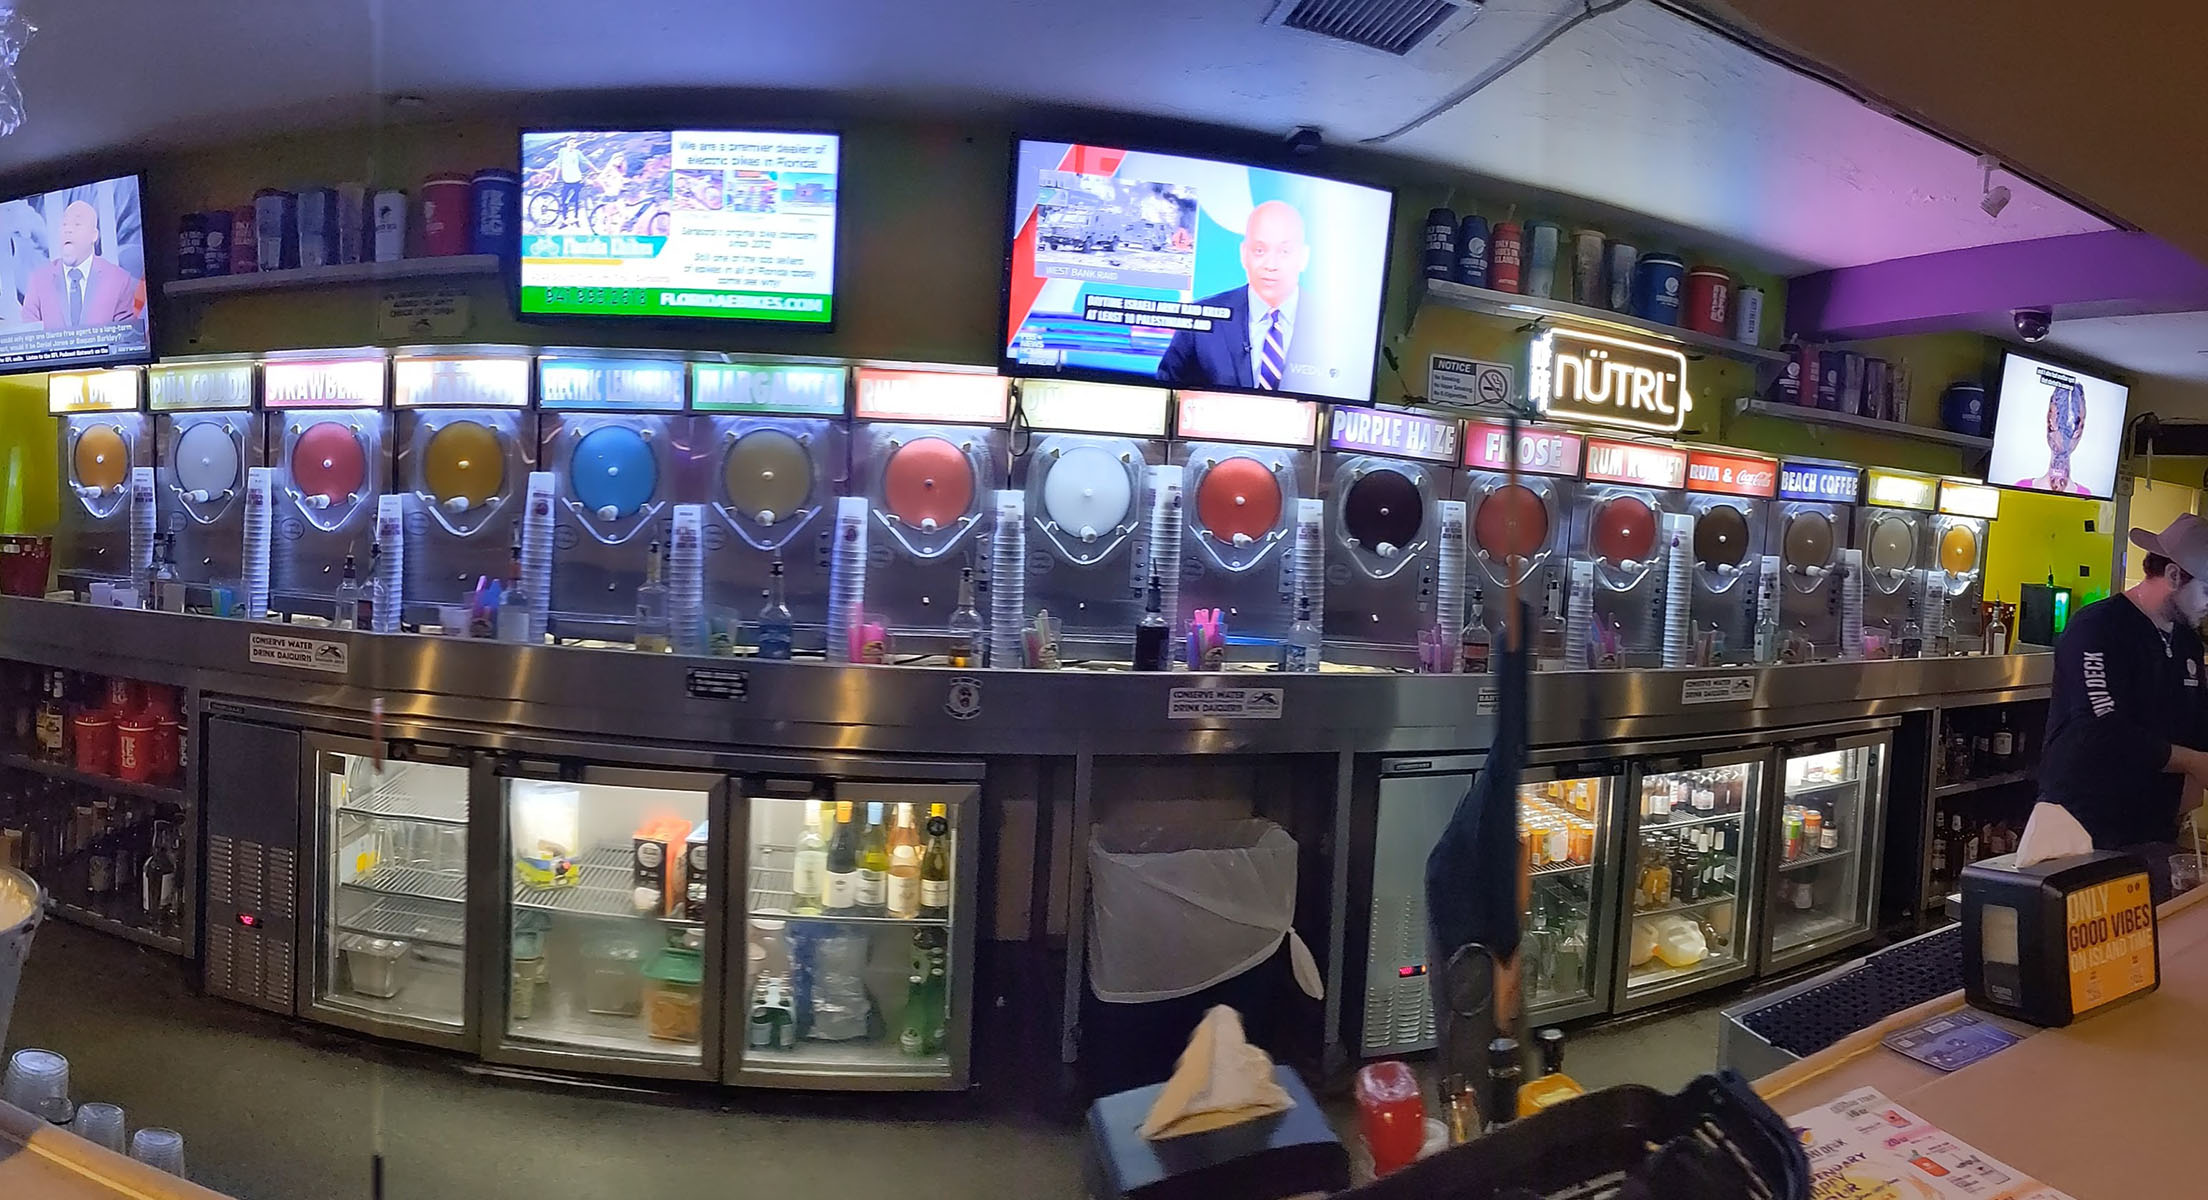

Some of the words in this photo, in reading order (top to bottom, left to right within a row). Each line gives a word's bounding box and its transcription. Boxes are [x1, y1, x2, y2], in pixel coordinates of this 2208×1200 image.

[1046, 266, 1070, 276] WEST
[1071, 268, 1096, 278] BANK
[1097, 270, 1119, 280] RAID
[1086, 309, 1097, 320] AT
[1097, 310, 1124, 323] LEAST
[1438, 360, 1471, 373] NOTICE
[152, 370, 186, 404] PIÑA
[1554, 349, 1676, 415] NÜTRL
[1332, 410, 1402, 448] PURPLE
[1406, 420, 1455, 455] HAZE
[1485, 432, 1563, 467] FROSÉ
[1588, 446, 1622, 476] RUM
[1690, 464, 1719, 482] RUM
[1722, 467, 1733, 483] &
[1781, 471, 1818, 493] BEACH
[1820, 474, 1858, 496] COFFEE
[252, 636, 286, 647] CONSERVE
[287, 640, 313, 650] WATER
[253, 648, 275, 658] DRINK
[277, 651, 312, 662] DAIQUIRIS
[2083, 651, 2107, 688] DECK
[1173, 691, 1215, 699] CONSERVE
[1173, 704, 1200, 712] DRINK
[2067, 885, 2108, 923] ONLY
[2069, 917, 2108, 952] GOOD
[2111, 904, 2150, 938] VIBES
[2071, 951, 2088, 974] ON
[2089, 938, 2127, 967] ISLAND
[2128, 928, 2153, 950] TIME
